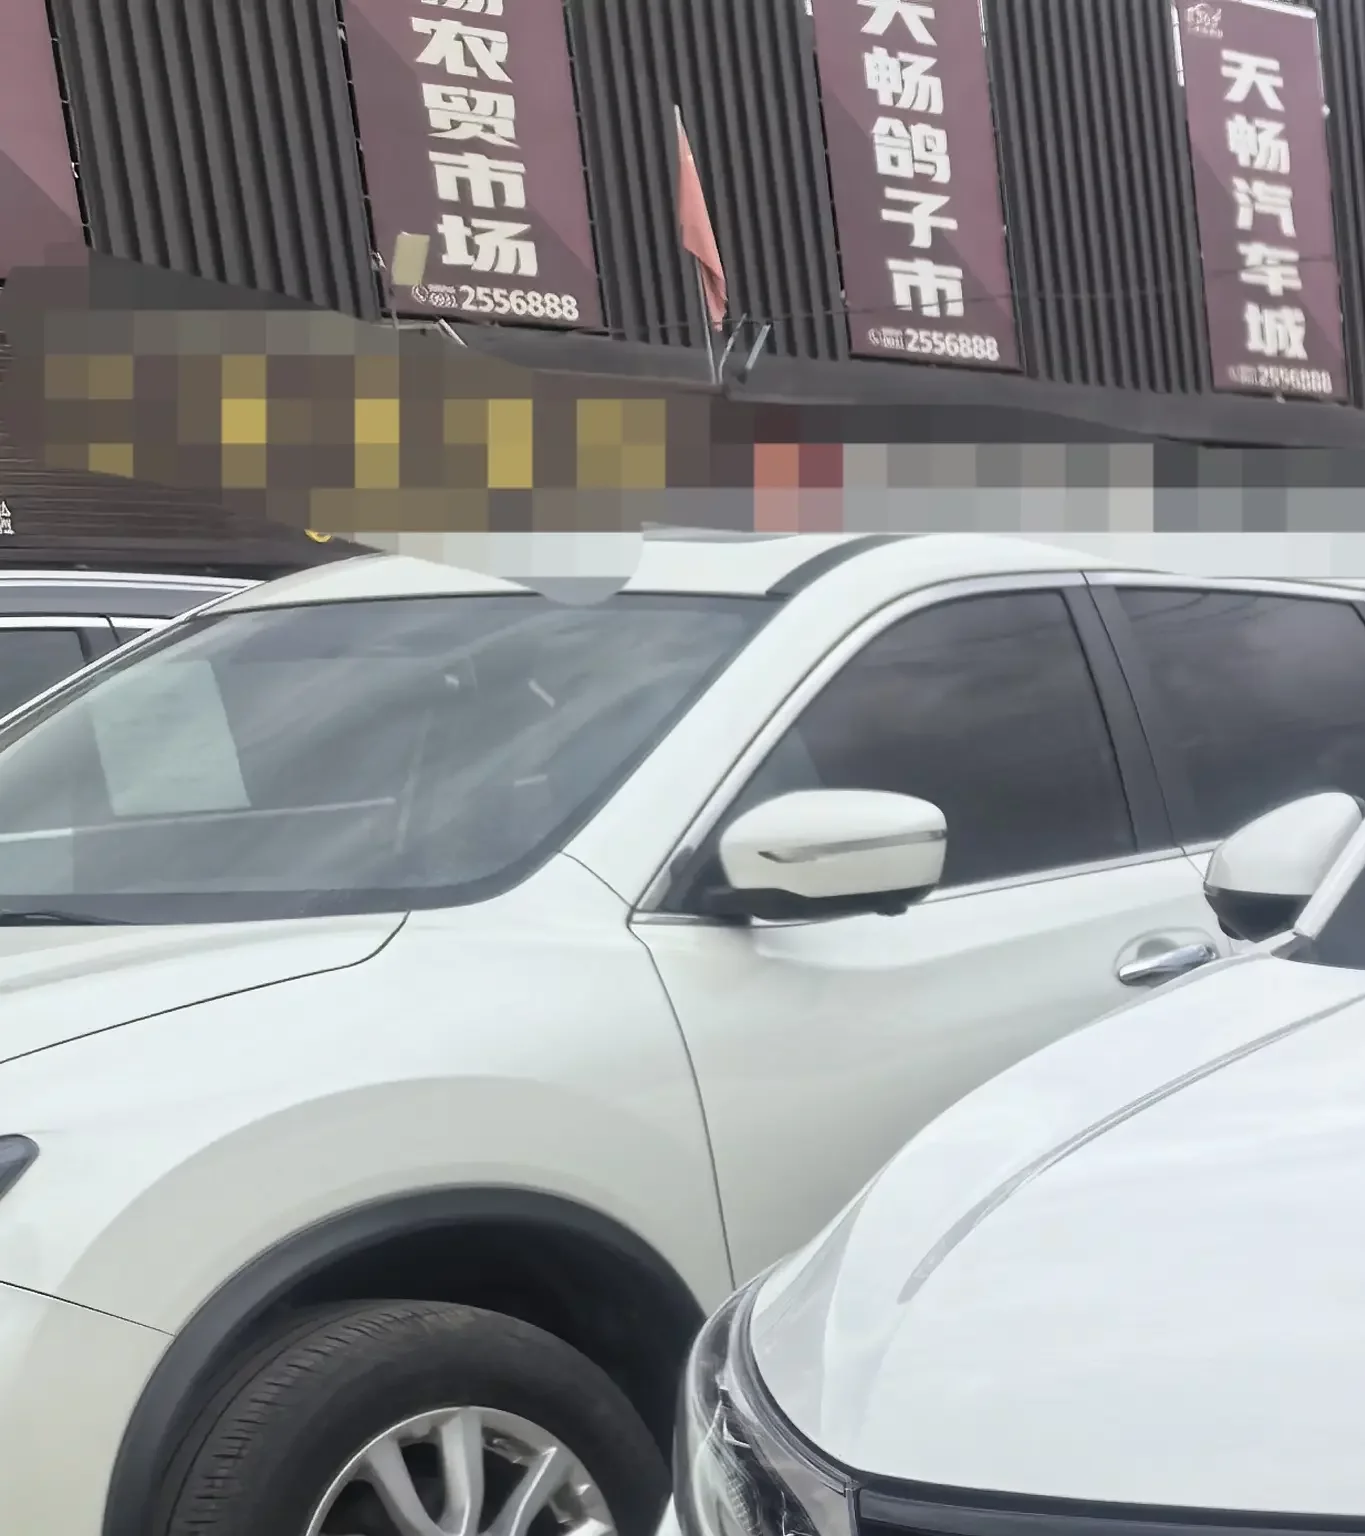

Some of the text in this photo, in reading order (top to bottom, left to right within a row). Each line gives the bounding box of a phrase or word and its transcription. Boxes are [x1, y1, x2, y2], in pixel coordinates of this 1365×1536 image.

[409, 0, 538, 277] 农贸市场
[1220, 49, 1308, 360] 天畅汽车城
[460, 285, 579, 321] 2556888
[905, 328, 1000, 361] 2556888
